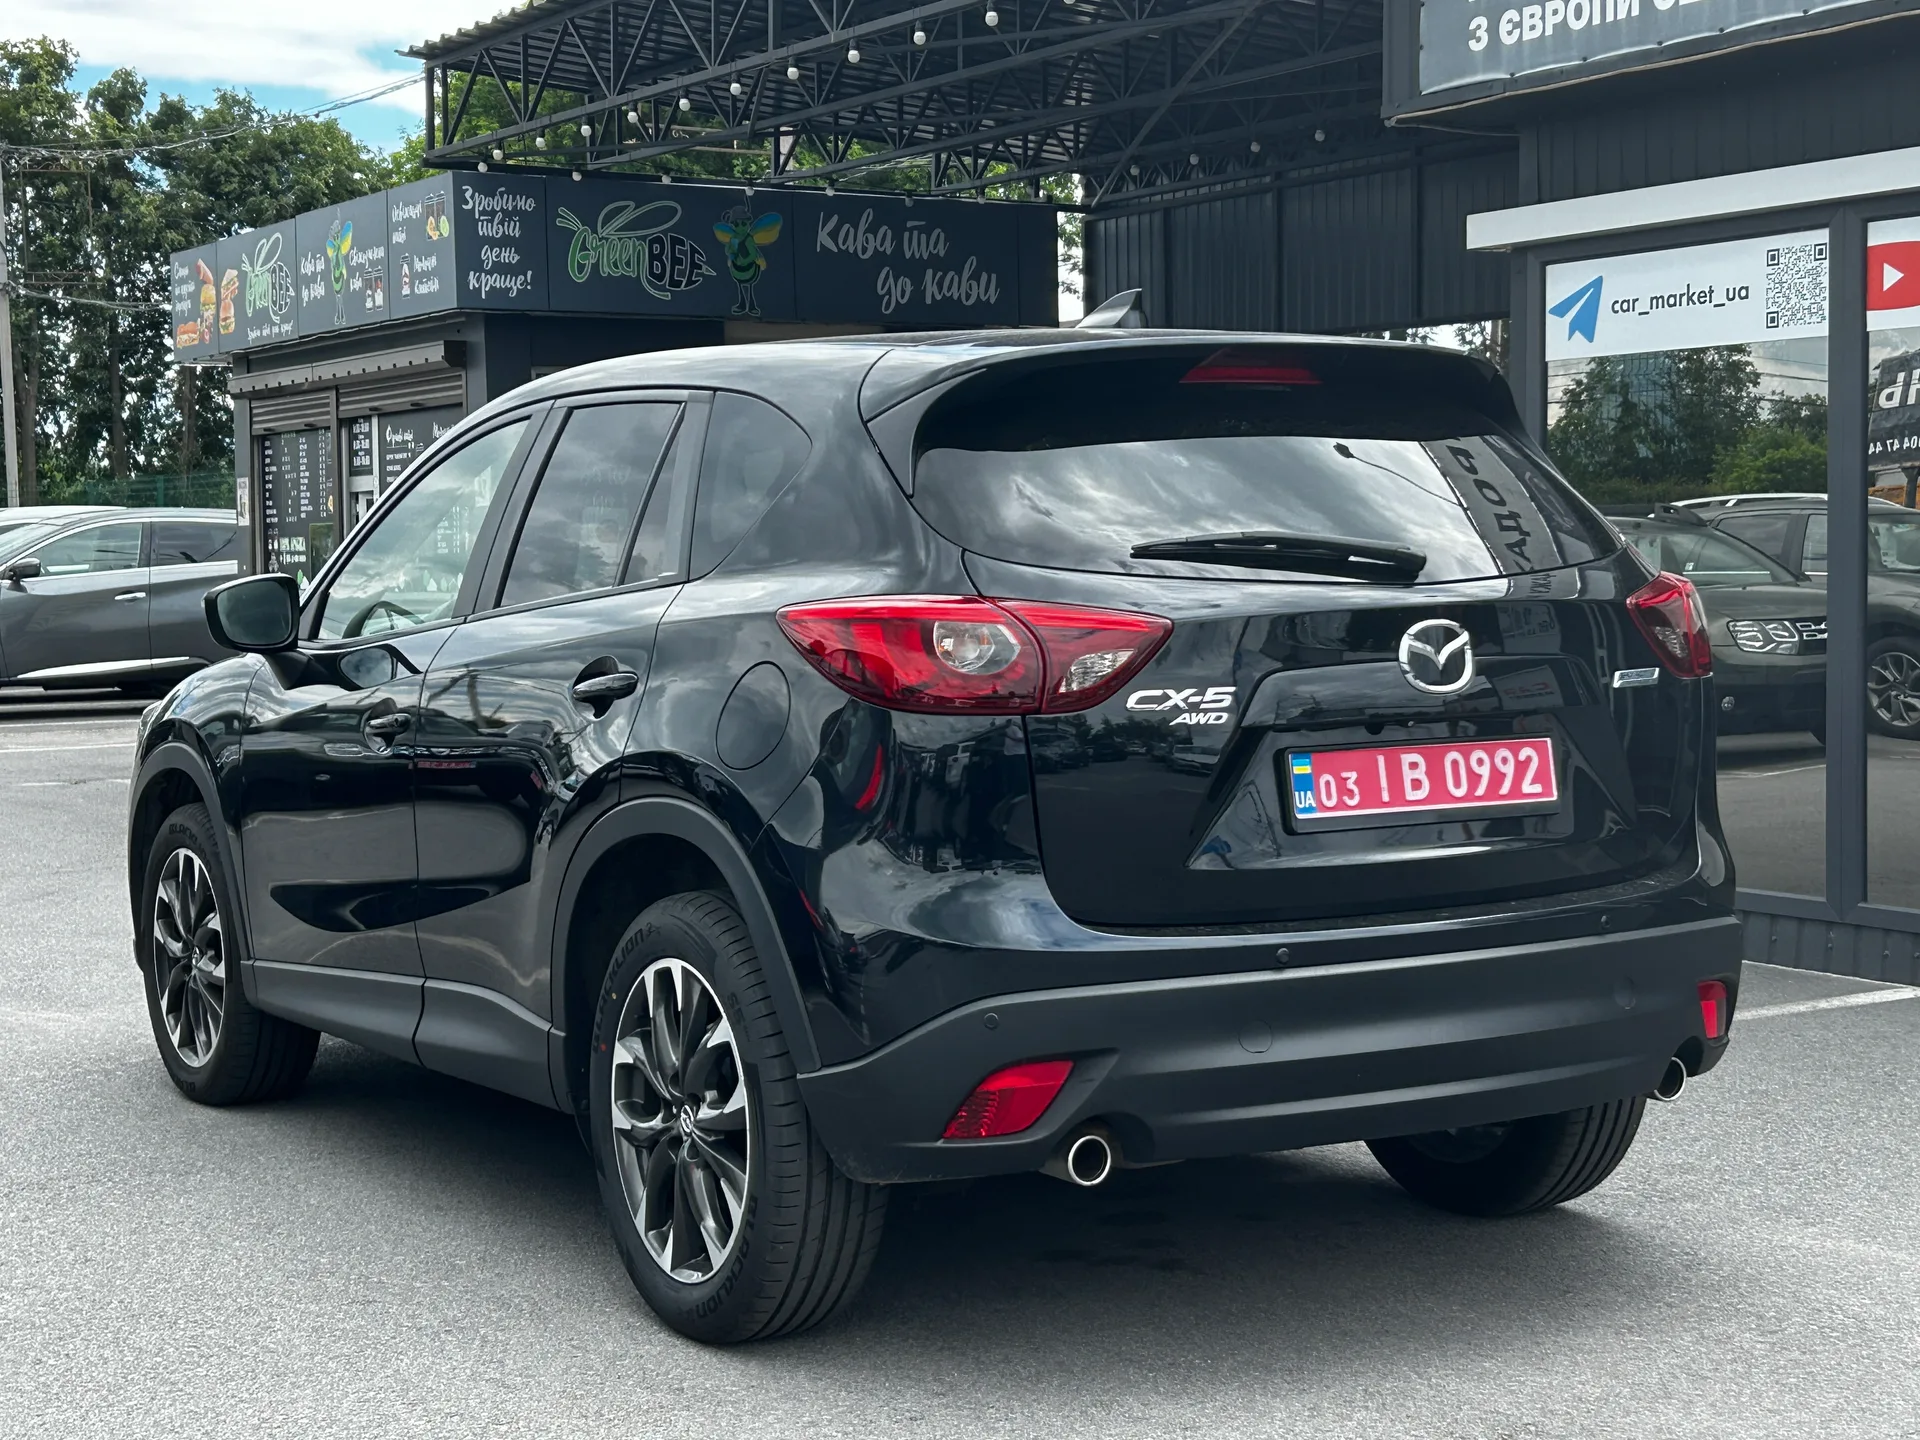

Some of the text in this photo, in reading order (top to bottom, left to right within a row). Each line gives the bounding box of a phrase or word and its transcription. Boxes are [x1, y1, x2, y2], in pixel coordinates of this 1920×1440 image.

[462, 186, 536, 219] Зробимо
[478, 212, 521, 238] твій
[817, 208, 949, 260] Кава та
[481, 245, 520, 270] день
[467, 270, 533, 299] краще!
[877, 256, 1000, 314] до кави
[1611, 283, 1750, 316] car_market_ua
[1126, 686, 1237, 711] CX-5
[1169, 712, 1229, 726] AWD
[1319, 771, 1361, 808] 03
[1444, 746, 1544, 798] 0992
[1295, 791, 1316, 808] UA
